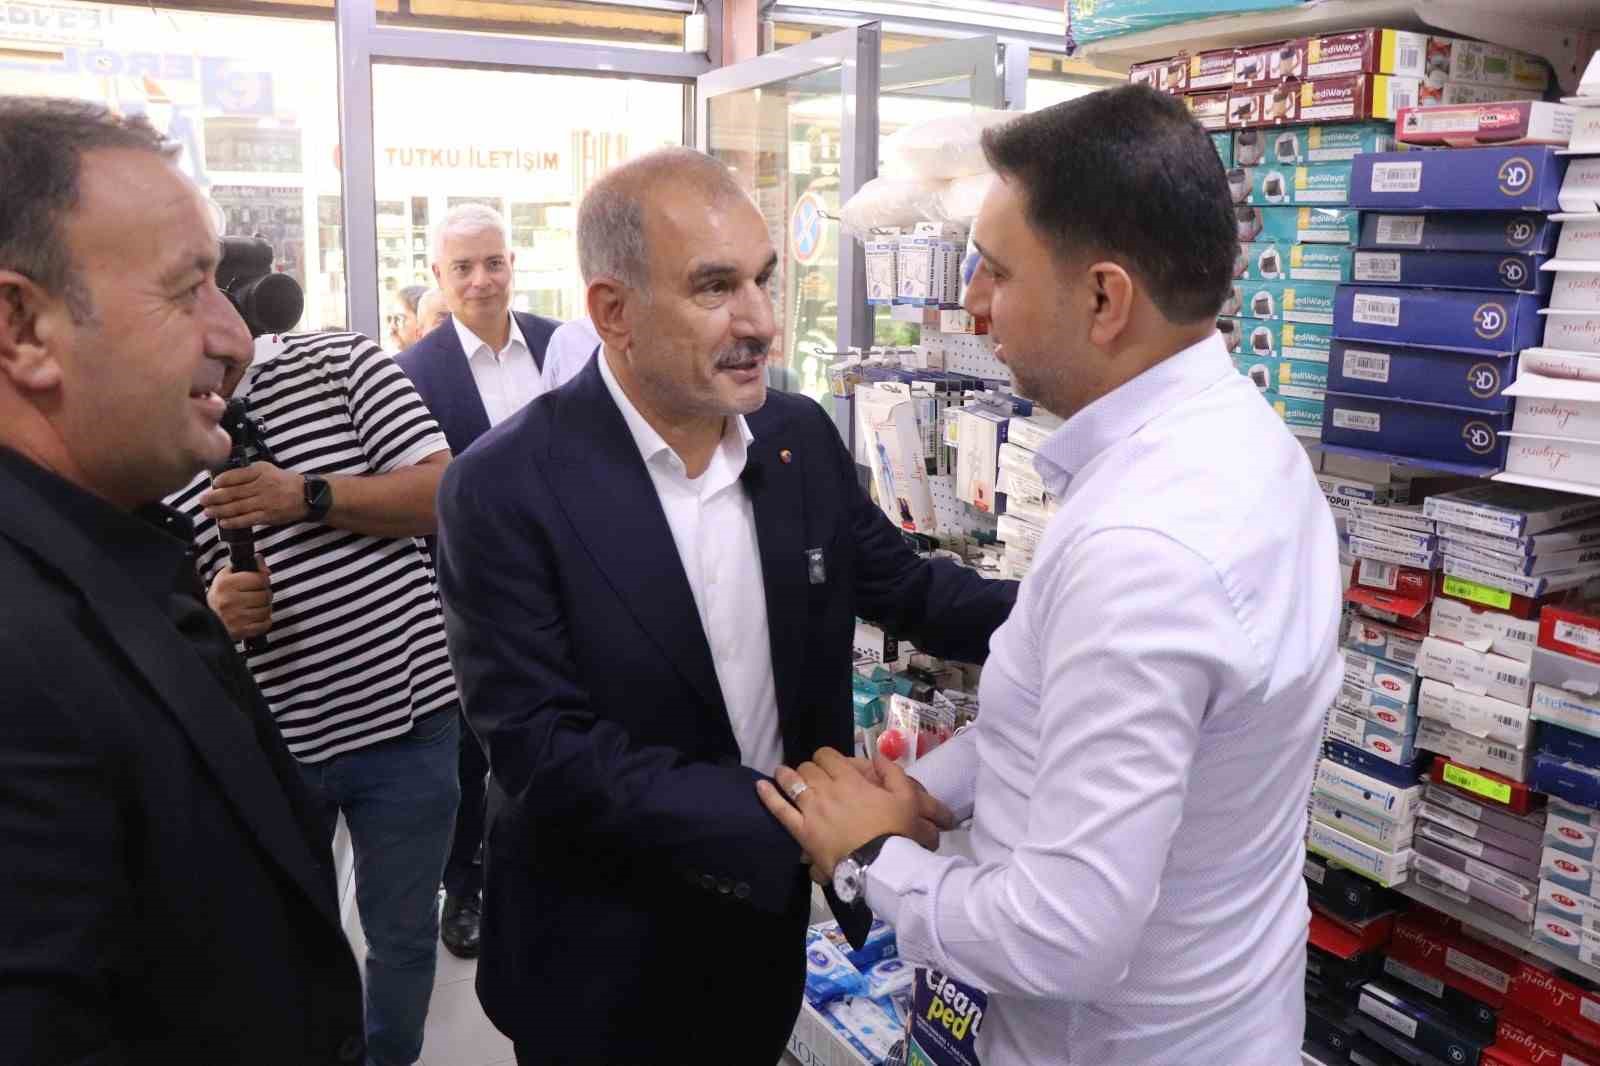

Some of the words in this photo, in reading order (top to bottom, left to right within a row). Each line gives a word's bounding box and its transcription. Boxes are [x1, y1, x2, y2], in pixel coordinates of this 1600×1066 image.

[385, 147, 461, 168] TUTKU
[926, 967, 982, 1037] Clean
[927, 995, 972, 1041] ped
